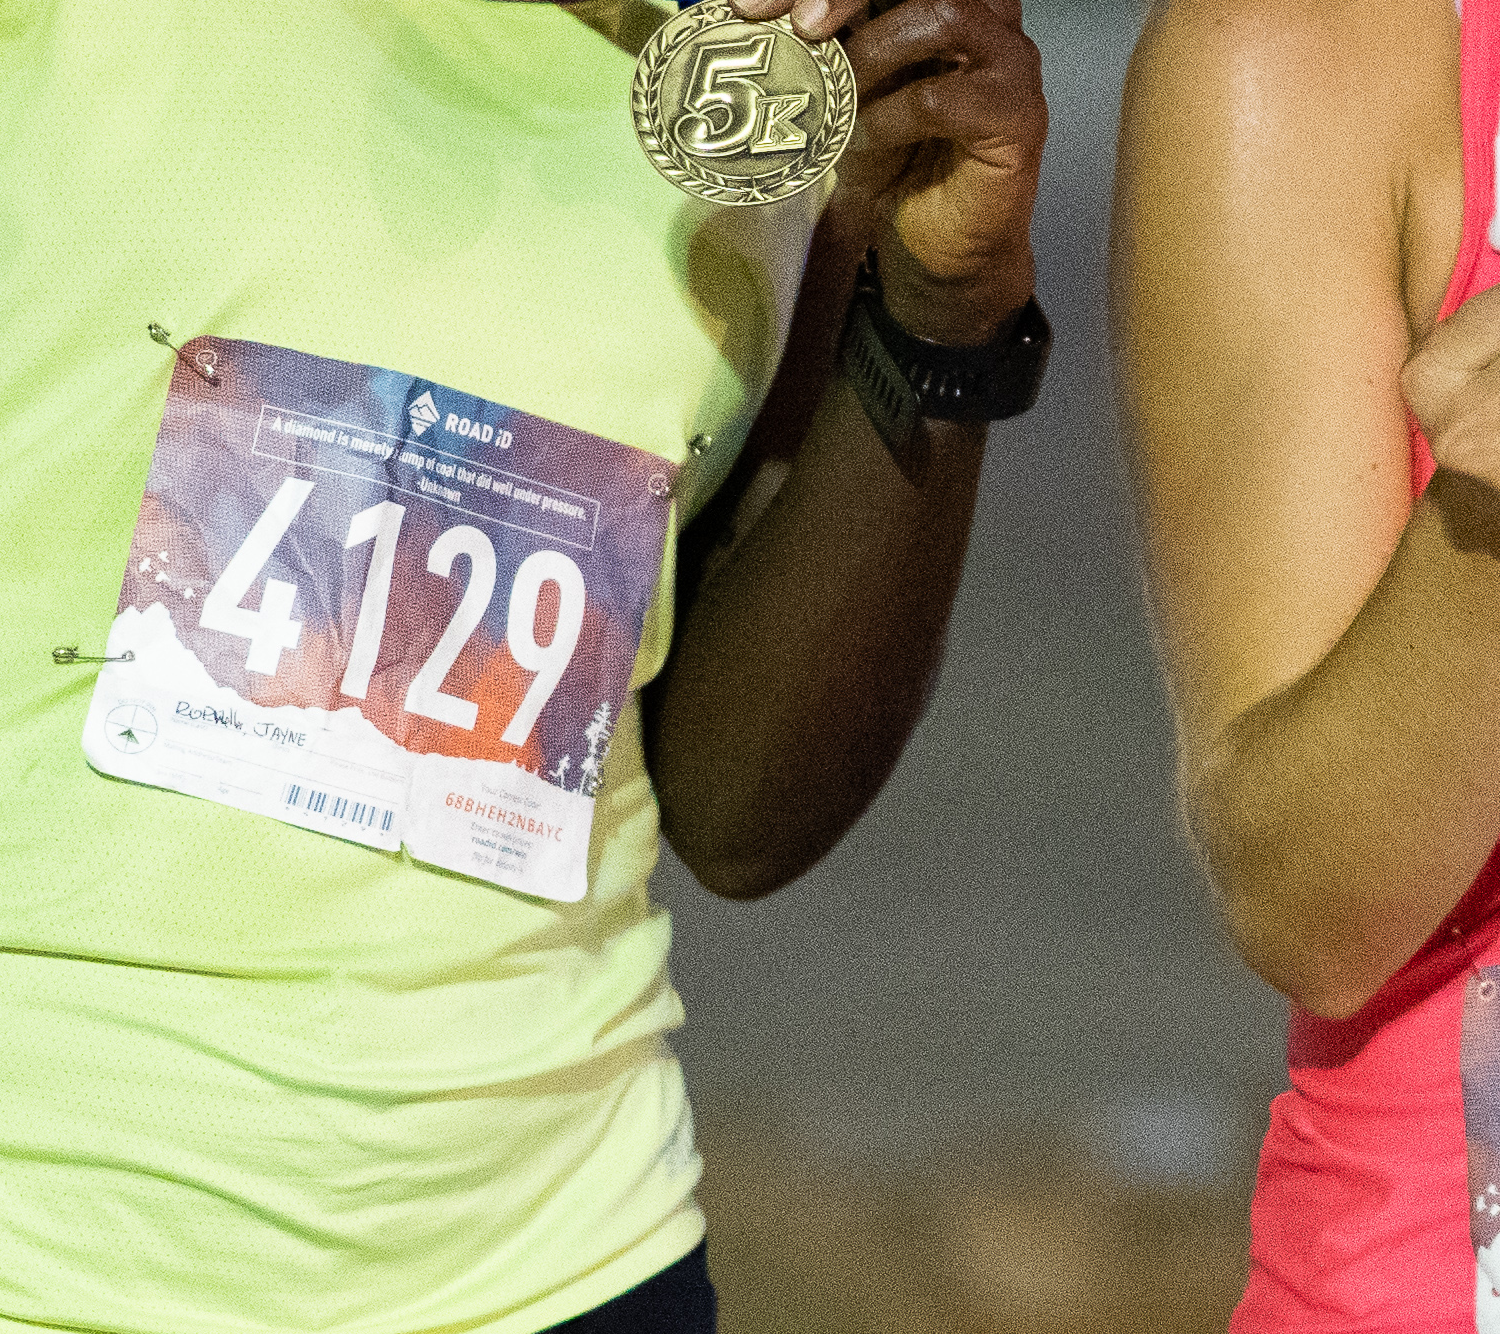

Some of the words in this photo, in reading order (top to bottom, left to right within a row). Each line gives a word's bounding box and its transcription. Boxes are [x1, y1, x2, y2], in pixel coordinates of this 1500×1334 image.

[674, 34, 811, 157] 5K
[271, 415, 284, 431] A
[282, 416, 336, 445] diamond
[336, 431, 349, 446] is
[349, 434, 394, 461] merely
[396, 449, 425, 470] ump
[434, 459, 457, 478] coal
[455, 466, 477, 484] that
[475, 473, 492, 489] did
[490, 478, 513, 496] well
[512, 484, 542, 505] under
[443, 412, 495, 443] ROAD
[200, 475, 587, 748] 4129
[251, 719, 307, 748] JAYNE
